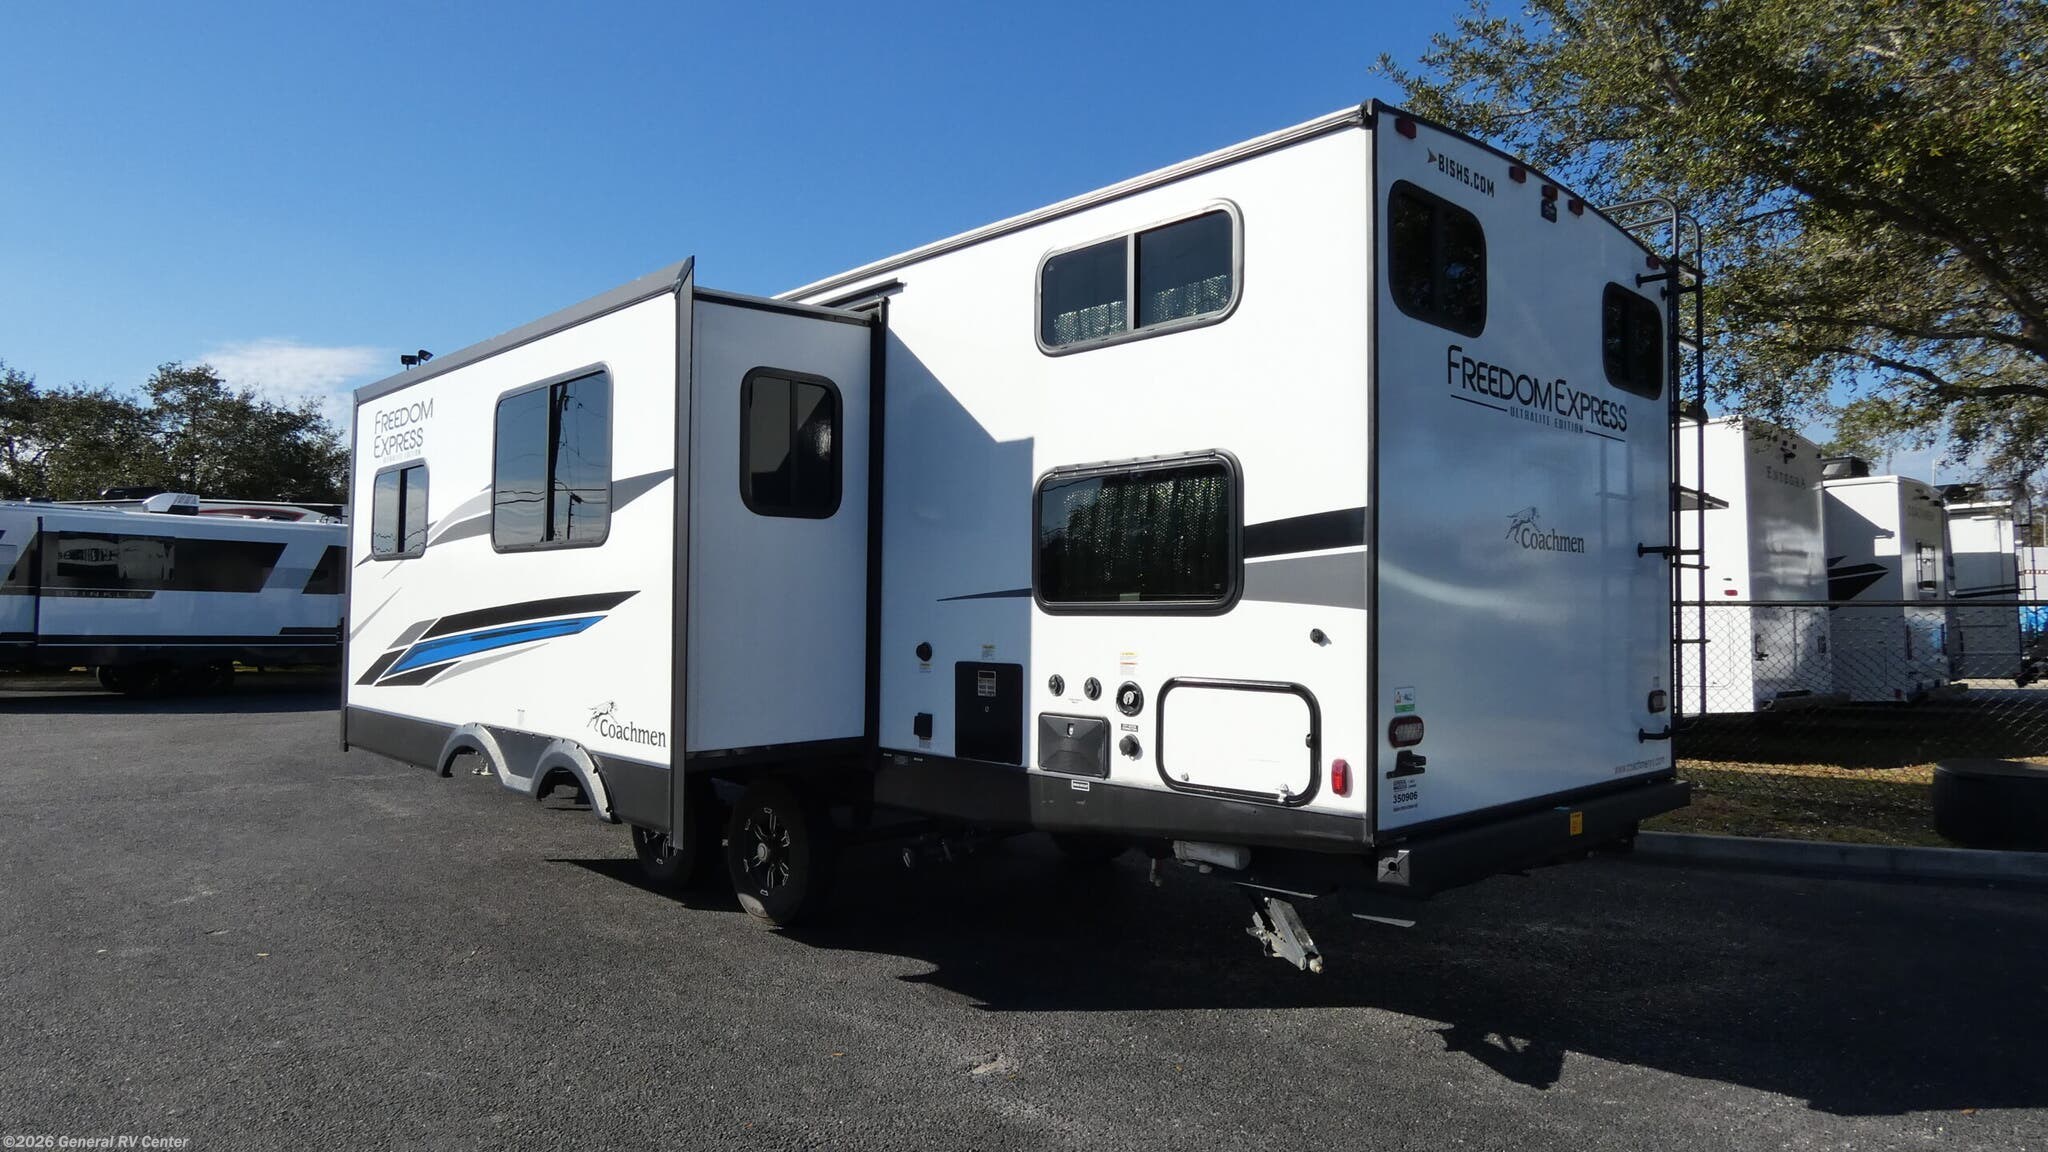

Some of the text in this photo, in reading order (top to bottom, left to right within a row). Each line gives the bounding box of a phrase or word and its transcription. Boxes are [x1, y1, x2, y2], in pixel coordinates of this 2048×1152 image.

[1438, 153, 1495, 198] BISHS.COM
[1448, 344, 1627, 432] FREEDOM EXPRESS
[374, 397, 434, 434] FREEDOM
[1510, 406, 1584, 434] ULTRALITE EDITION
[373, 427, 424, 459] EXPRESS
[1521, 527, 1585, 554] Coachmen
[600, 718, 666, 748] Coachmen
[1392, 791, 1418, 804] 350906
